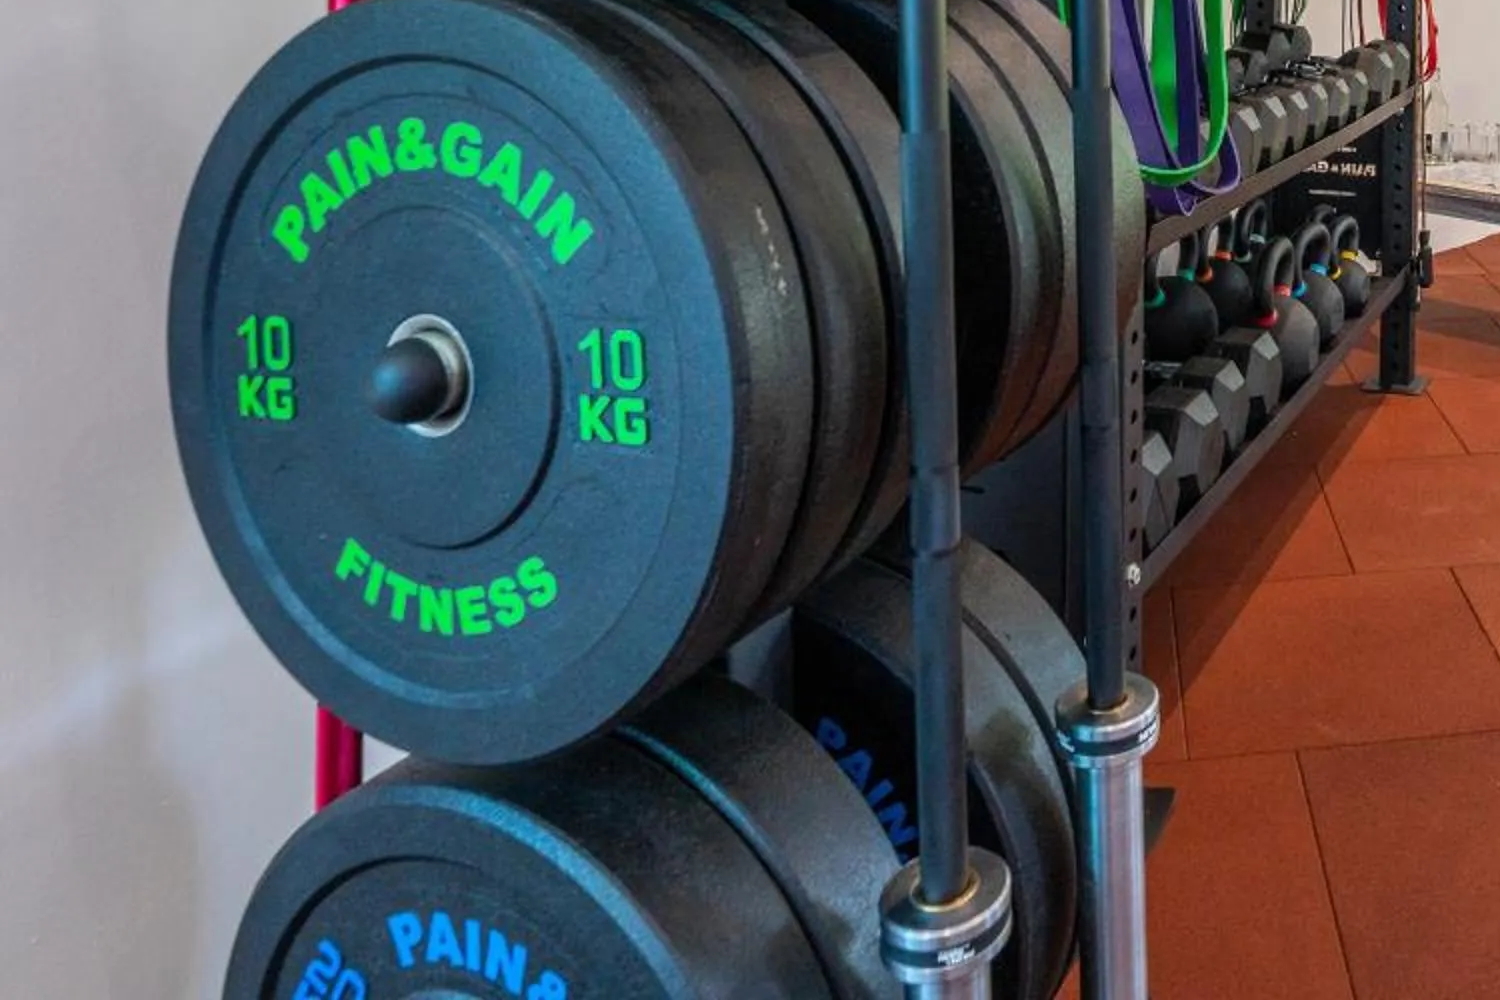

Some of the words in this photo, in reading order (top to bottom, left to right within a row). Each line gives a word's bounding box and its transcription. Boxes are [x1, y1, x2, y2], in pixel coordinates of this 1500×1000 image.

[270, 115, 594, 265] PAIN&GAIN
[236, 314, 291, 371] 10
[576, 328, 645, 393] 10
[237, 374, 295, 421] KG
[577, 393, 648, 447] KG
[334, 536, 560, 637] FITNESS
